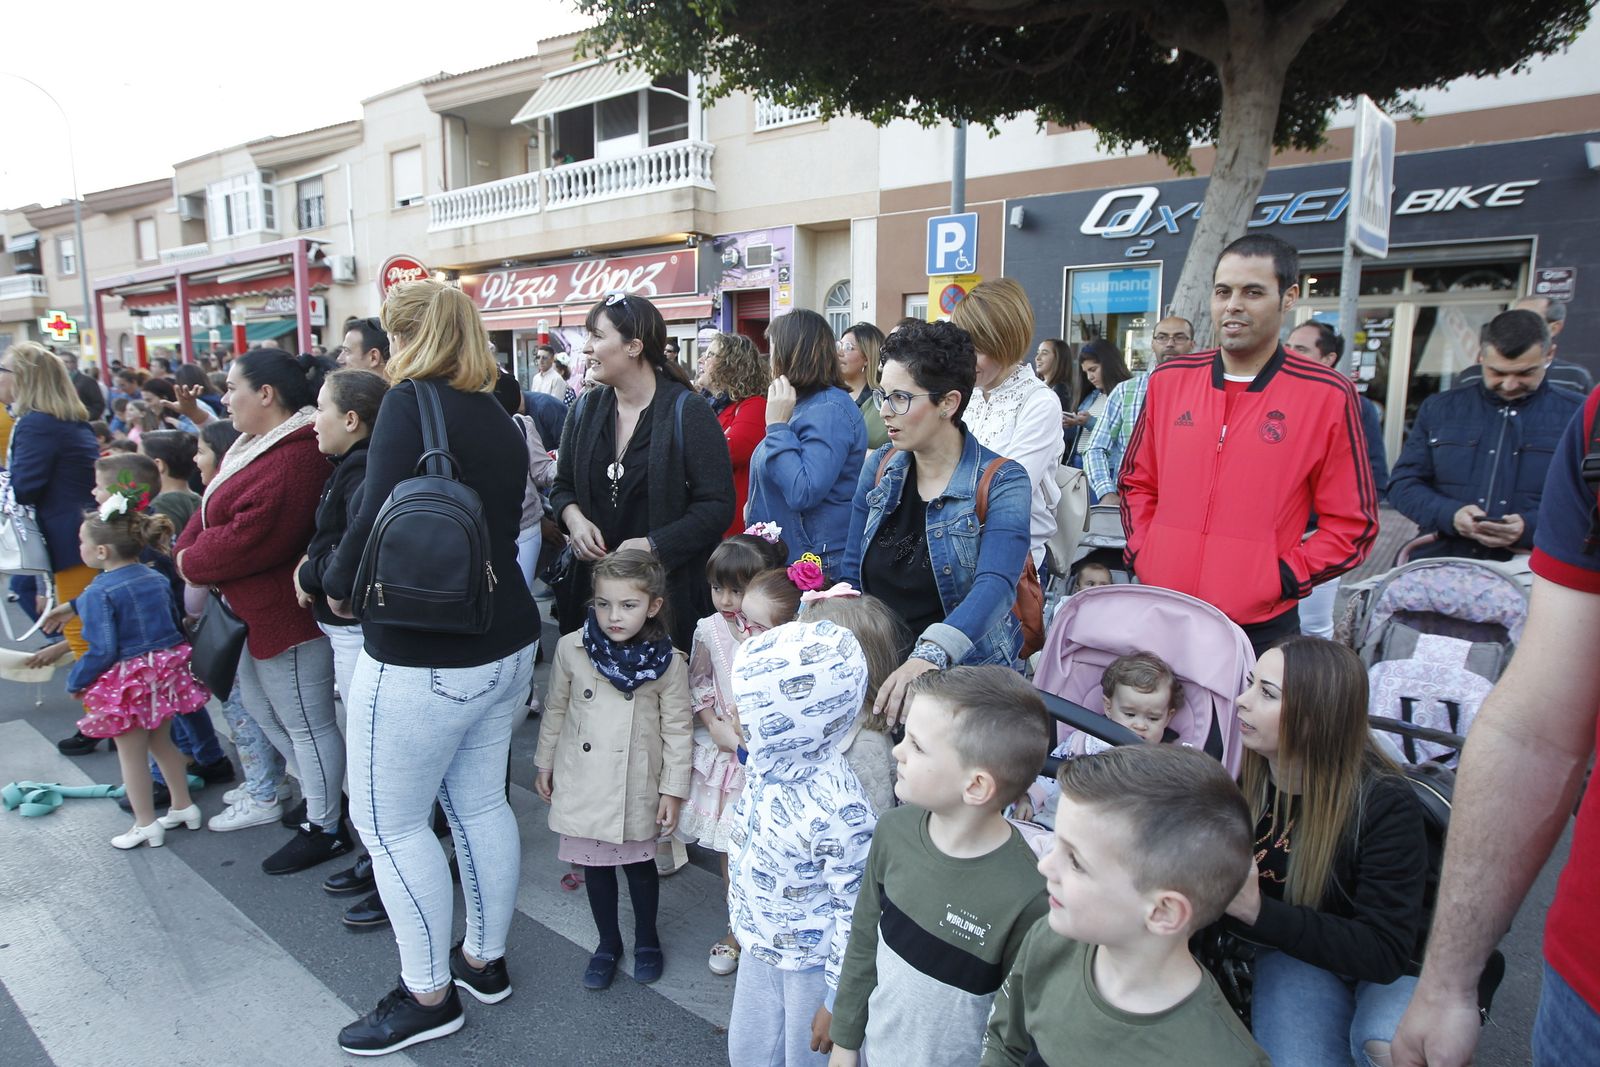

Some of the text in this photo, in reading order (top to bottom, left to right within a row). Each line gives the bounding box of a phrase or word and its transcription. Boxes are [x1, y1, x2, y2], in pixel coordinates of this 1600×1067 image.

[1395, 179, 1541, 215] BIKE
[936, 222, 967, 269] P
[1125, 239, 1155, 256] 2
[480, 259, 667, 309] Pizza López
[1081, 279, 1152, 294] SHIMANO
